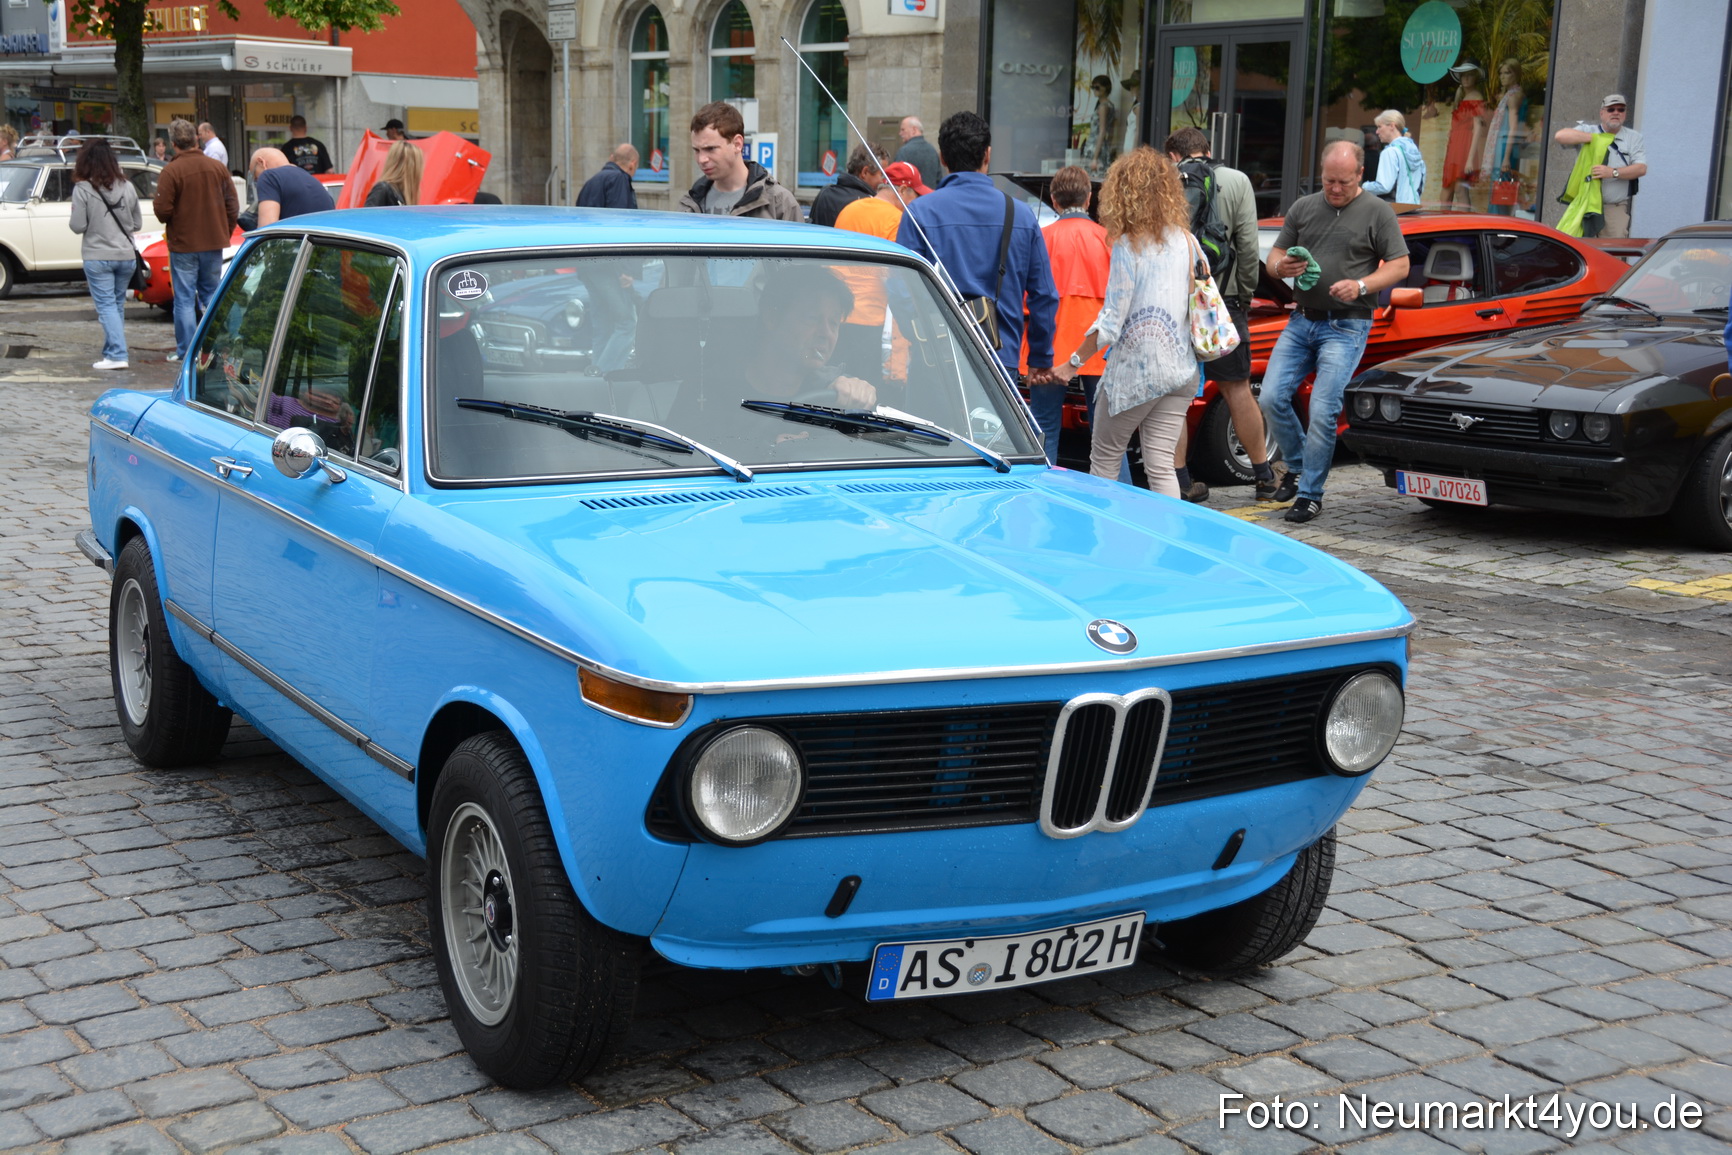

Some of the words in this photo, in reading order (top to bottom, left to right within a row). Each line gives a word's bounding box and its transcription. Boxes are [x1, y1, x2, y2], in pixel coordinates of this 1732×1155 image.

[1402, 29, 1458, 49] SUMMER
[1411, 40, 1453, 71] flair
[266, 61, 324, 72] SCHLIERF
[999, 62, 1064, 85] orsay
[72, 90, 89, 98] NZ
[761, 146, 772, 165] P
[1407, 475, 1431, 495] LIP
[1439, 480, 1481, 502] 07026
[878, 977, 889, 990] D
[899, 947, 965, 991] AS
